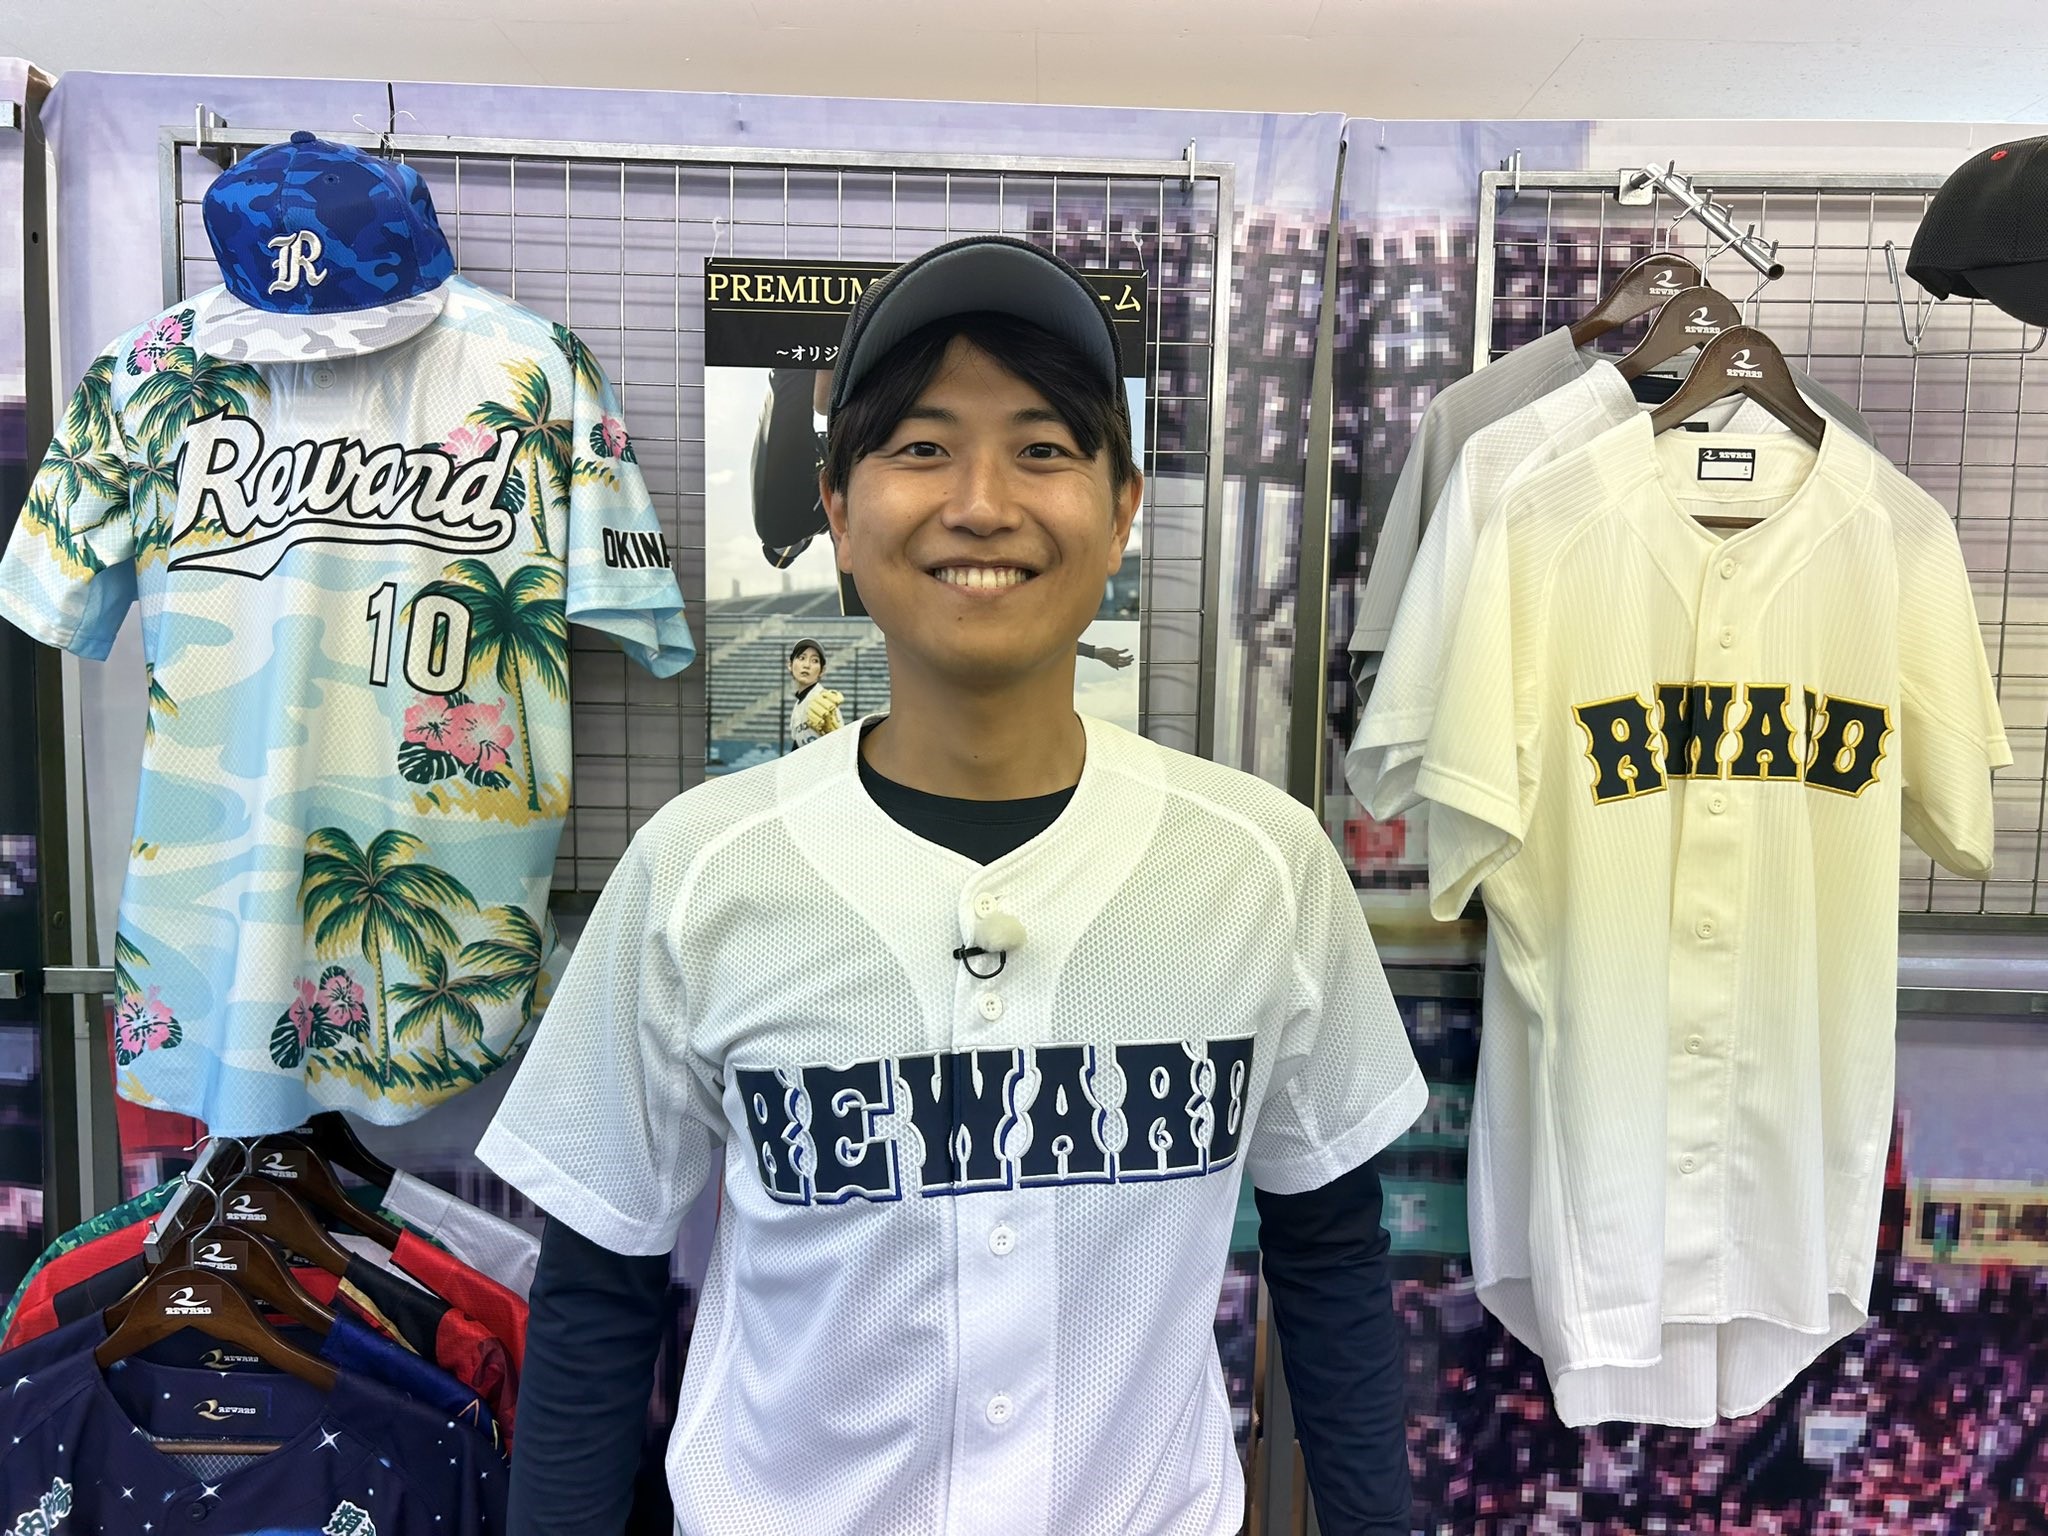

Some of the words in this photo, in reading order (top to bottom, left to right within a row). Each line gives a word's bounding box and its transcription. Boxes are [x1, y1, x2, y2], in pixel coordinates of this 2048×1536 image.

[268, 230, 328, 295] R
[1684, 325, 1721, 334] REWARD
[1726, 368, 1763, 378] REWARD
[169, 402, 521, 545] Reward
[366, 581, 472, 696] 10
[734, 1031, 1257, 1207] REWARD
[226, 1212, 267, 1221] REWARD
[165, 1307, 212, 1315] REWARD
[218, 1406, 256, 1415] REWARD
